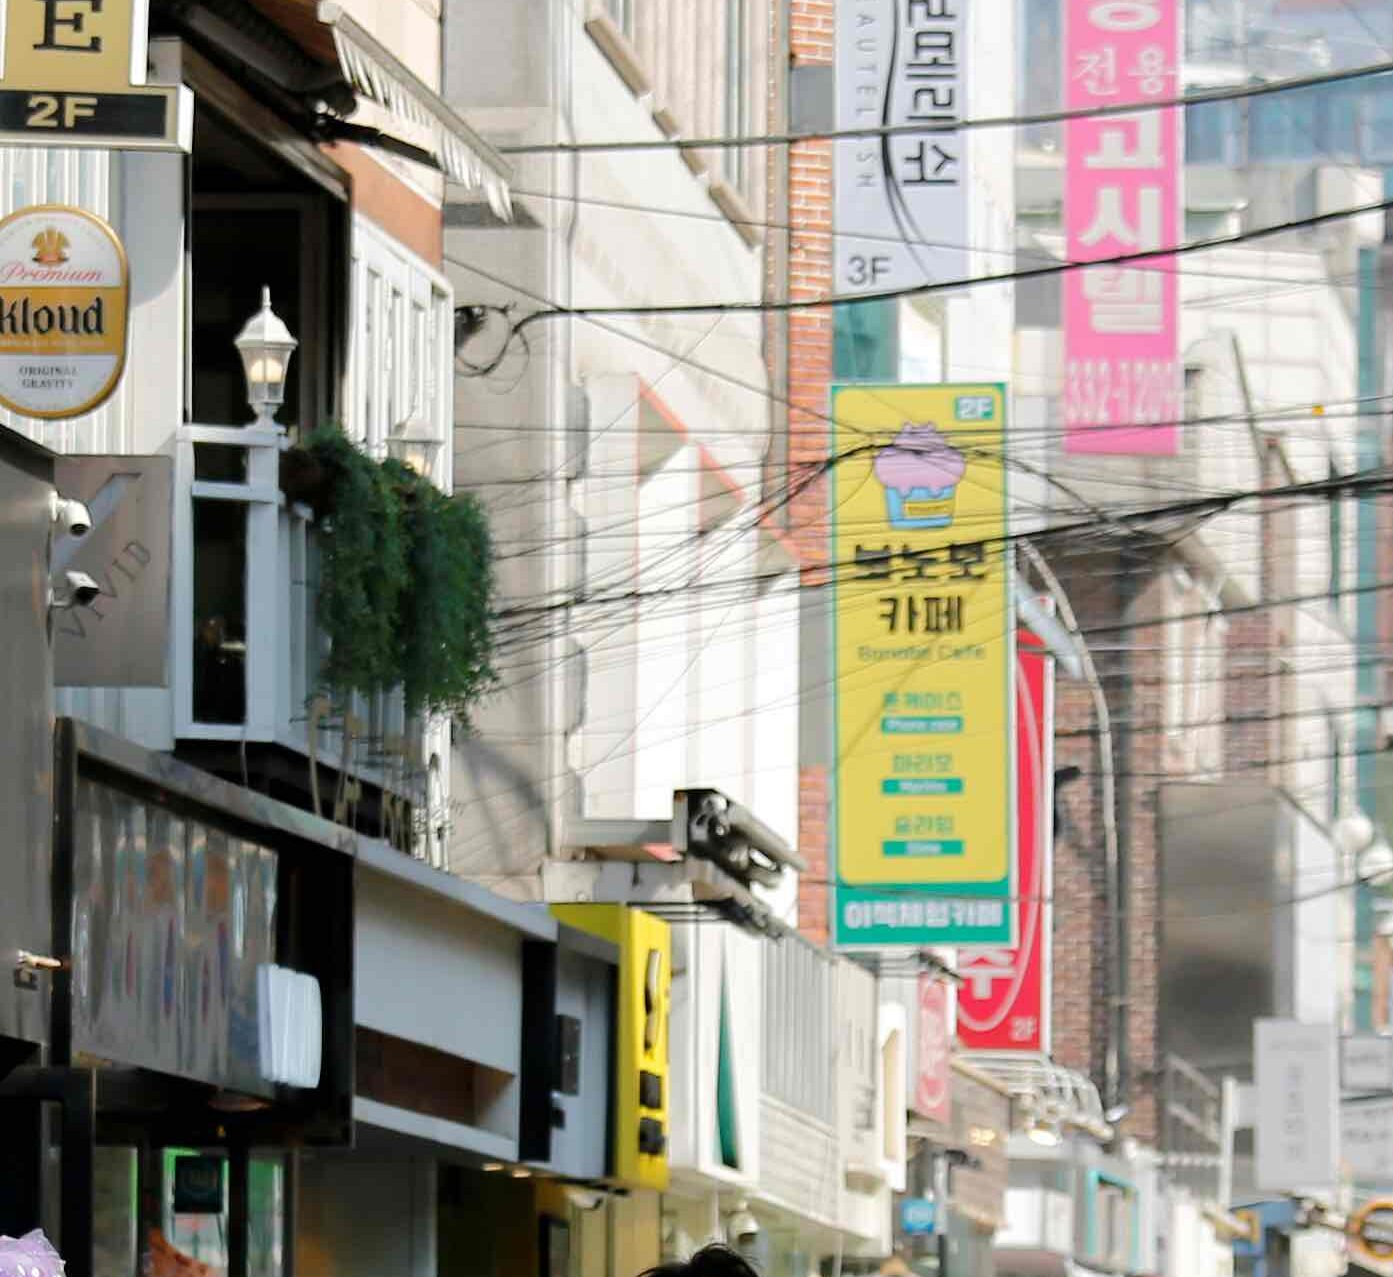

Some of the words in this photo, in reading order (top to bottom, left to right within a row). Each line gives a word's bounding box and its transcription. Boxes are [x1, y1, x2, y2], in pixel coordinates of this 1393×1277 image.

[26, 94, 99, 129] 2F
[0, 260, 104, 284] Premium
[847, 255, 892, 286] 3F
[878, 595, 964, 634] 카페
